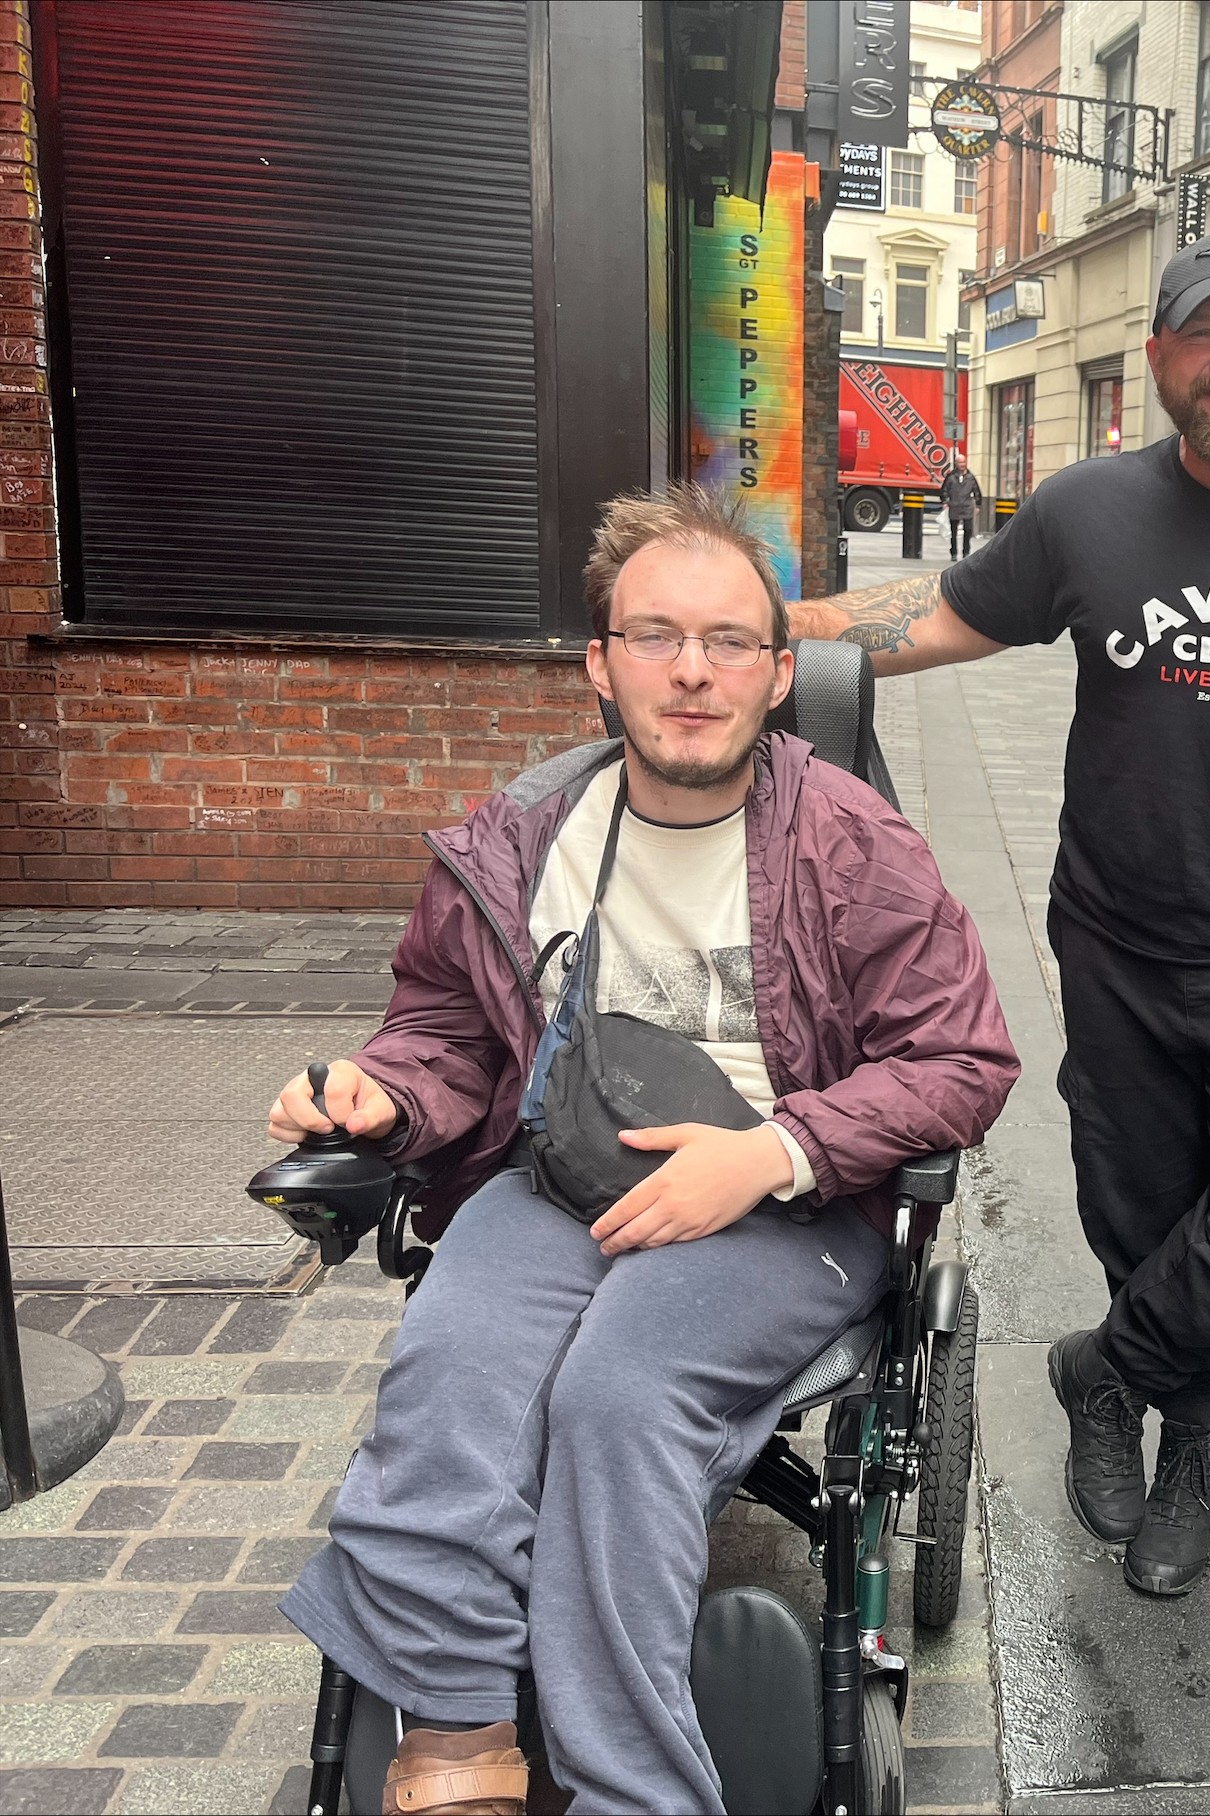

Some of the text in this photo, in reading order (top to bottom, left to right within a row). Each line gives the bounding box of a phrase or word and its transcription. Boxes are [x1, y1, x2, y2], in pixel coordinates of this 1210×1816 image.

[936, 85, 996, 116] THE CAVERN
[942, 135, 990, 155] QUARTER
[1186, 182, 1199, 229] WALL
[740, 287, 760, 488] PEPPERS
[240, 658, 279, 668] JENNY
[286, 659, 311, 669] DAD
